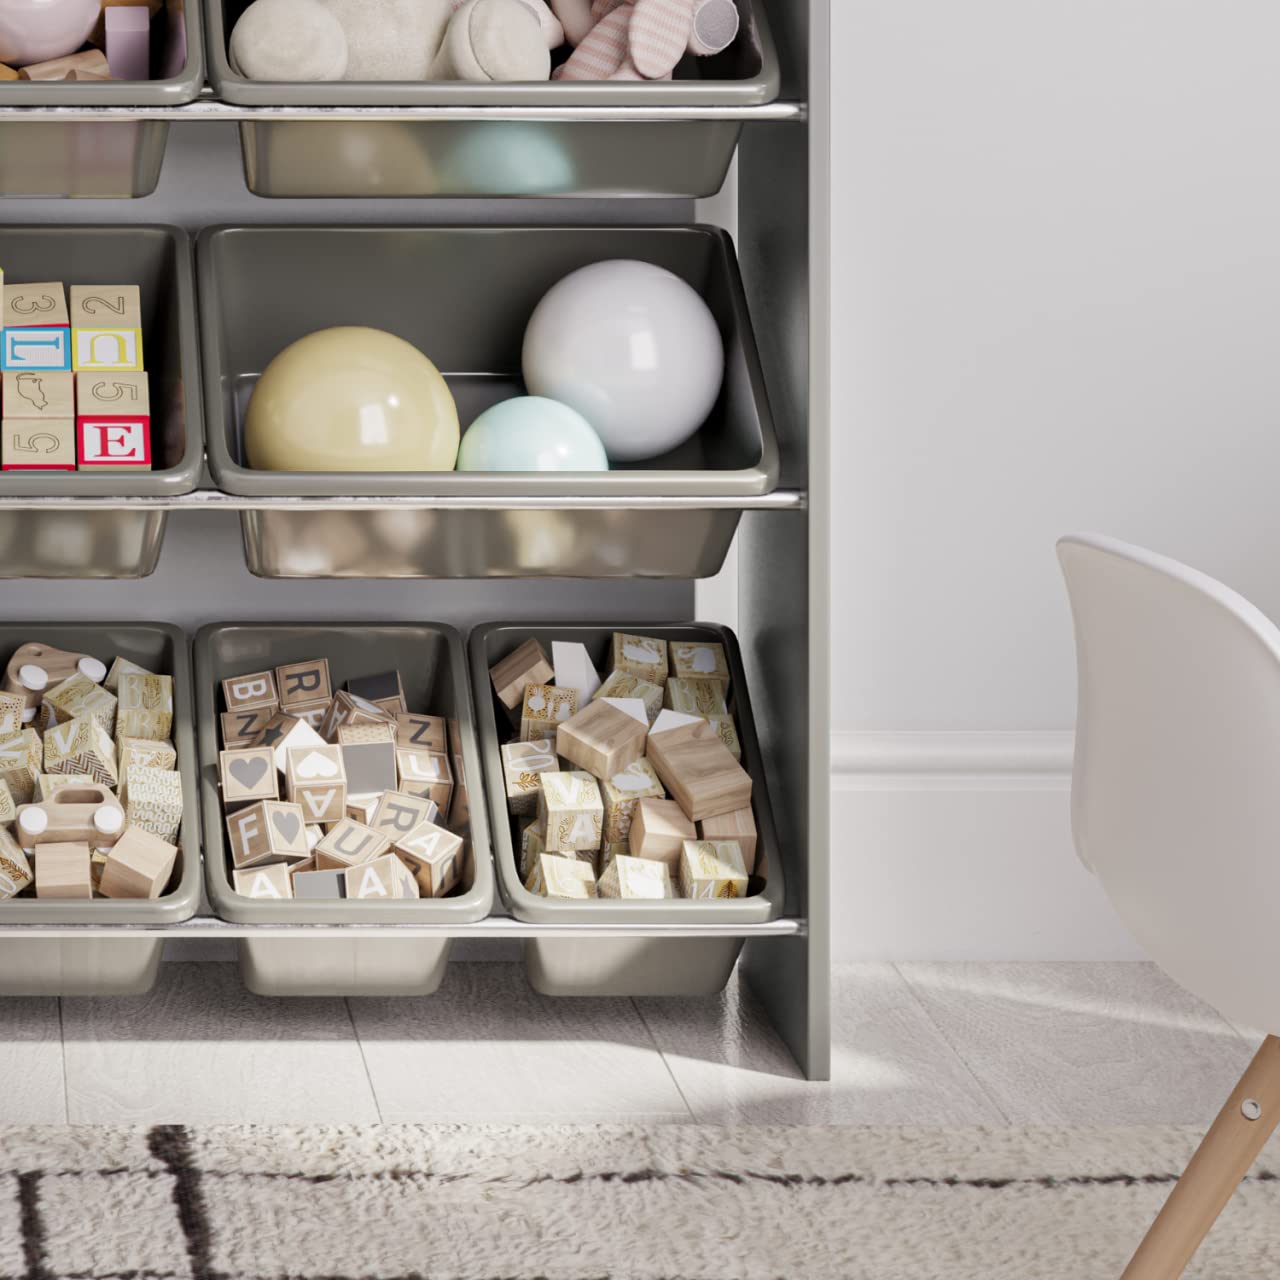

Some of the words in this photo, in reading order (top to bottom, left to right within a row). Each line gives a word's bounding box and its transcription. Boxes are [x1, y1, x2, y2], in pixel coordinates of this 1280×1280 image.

[11, 295, 56, 314] 3
[82, 296, 125, 314] 2
[92, 381, 138, 402] 5
[13, 433, 60, 454] 5
[93, 426, 137, 457] E
[232, 678, 267, 700] B
[285, 669, 320, 695] R
[302, 789, 337, 817] A
[379, 802, 420, 832] R
[569, 813, 597, 844] A
[237, 813, 258, 856] F
[333, 826, 373, 863] U
[407, 831, 441, 856] A
[250, 872, 281, 897] A
[357, 866, 388, 897] A
